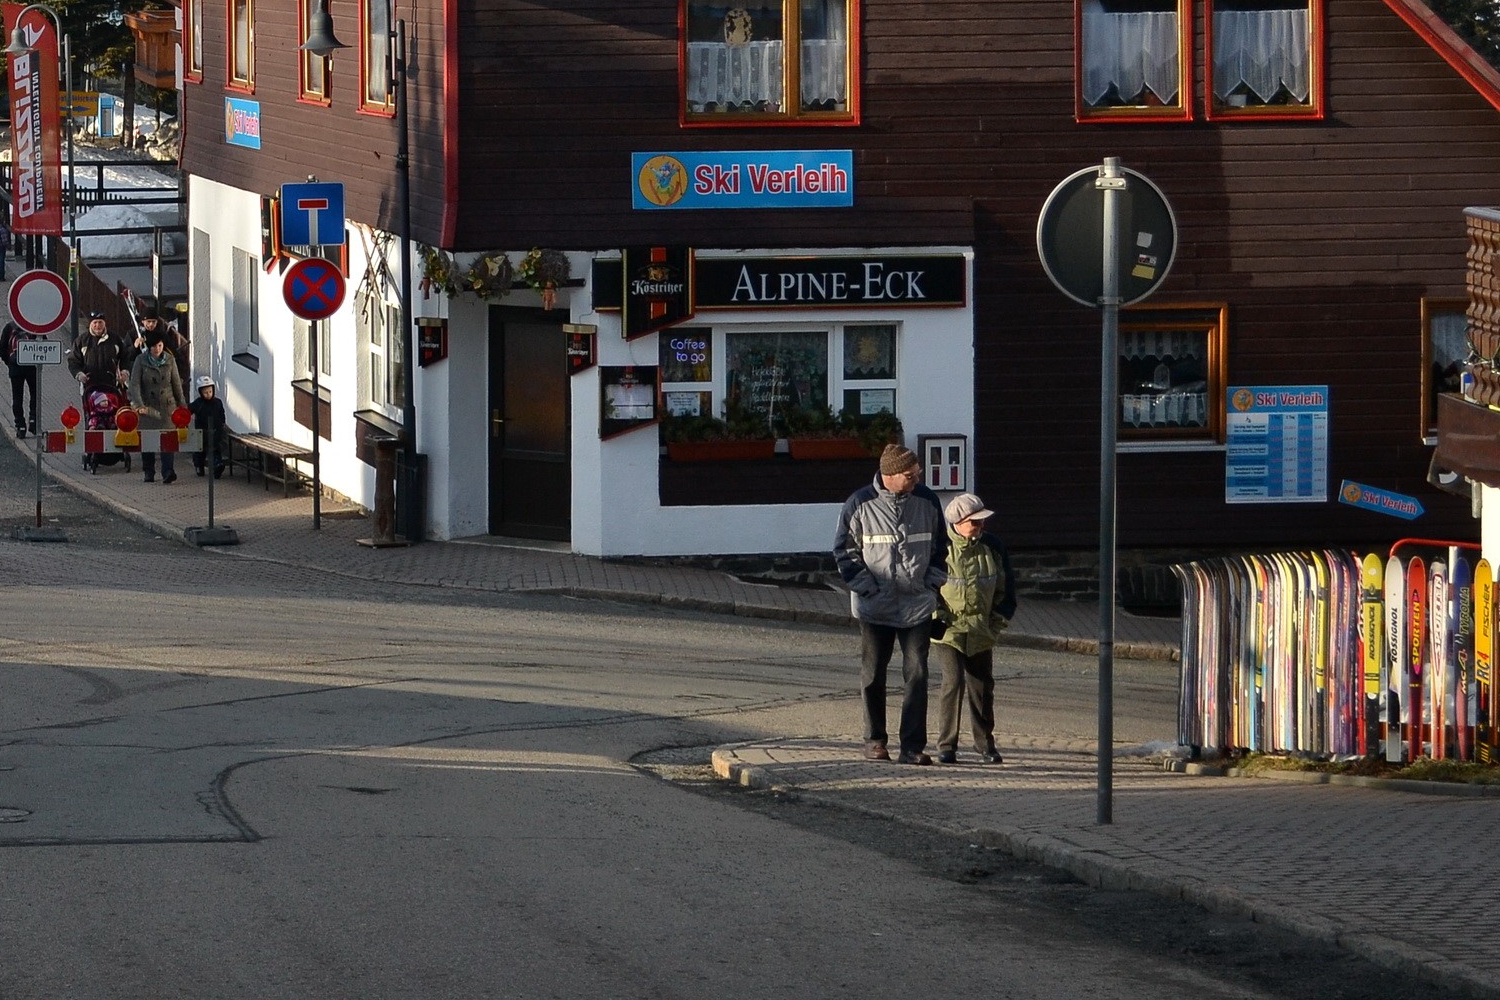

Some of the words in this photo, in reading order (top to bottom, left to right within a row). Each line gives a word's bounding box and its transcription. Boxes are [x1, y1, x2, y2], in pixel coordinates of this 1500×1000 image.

[694, 164, 740, 195] Ski
[747, 163, 847, 195] Verleih
[631, 279, 684, 297] Köstritzer
[23, 344, 57, 353] Anlieger
[670, 338, 706, 350] Coffee
[33, 353, 47, 361] frei
[676, 351, 688, 362] to
[690, 353, 706, 365] go
[1257, 392, 1277, 406] Ski
[1279, 391, 1324, 406] Verleih
[1362, 490, 1380, 505] Ski
[1381, 494, 1418, 515] Verleih
[1434, 575, 1443, 656] SPORTEN
[1459, 586, 1470, 635] TYROLIA
[1482, 583, 1490, 638] FISCHER
[1390, 606, 1398, 664] ROSSIGNOL
[1412, 600, 1420, 666] SPORTEN
